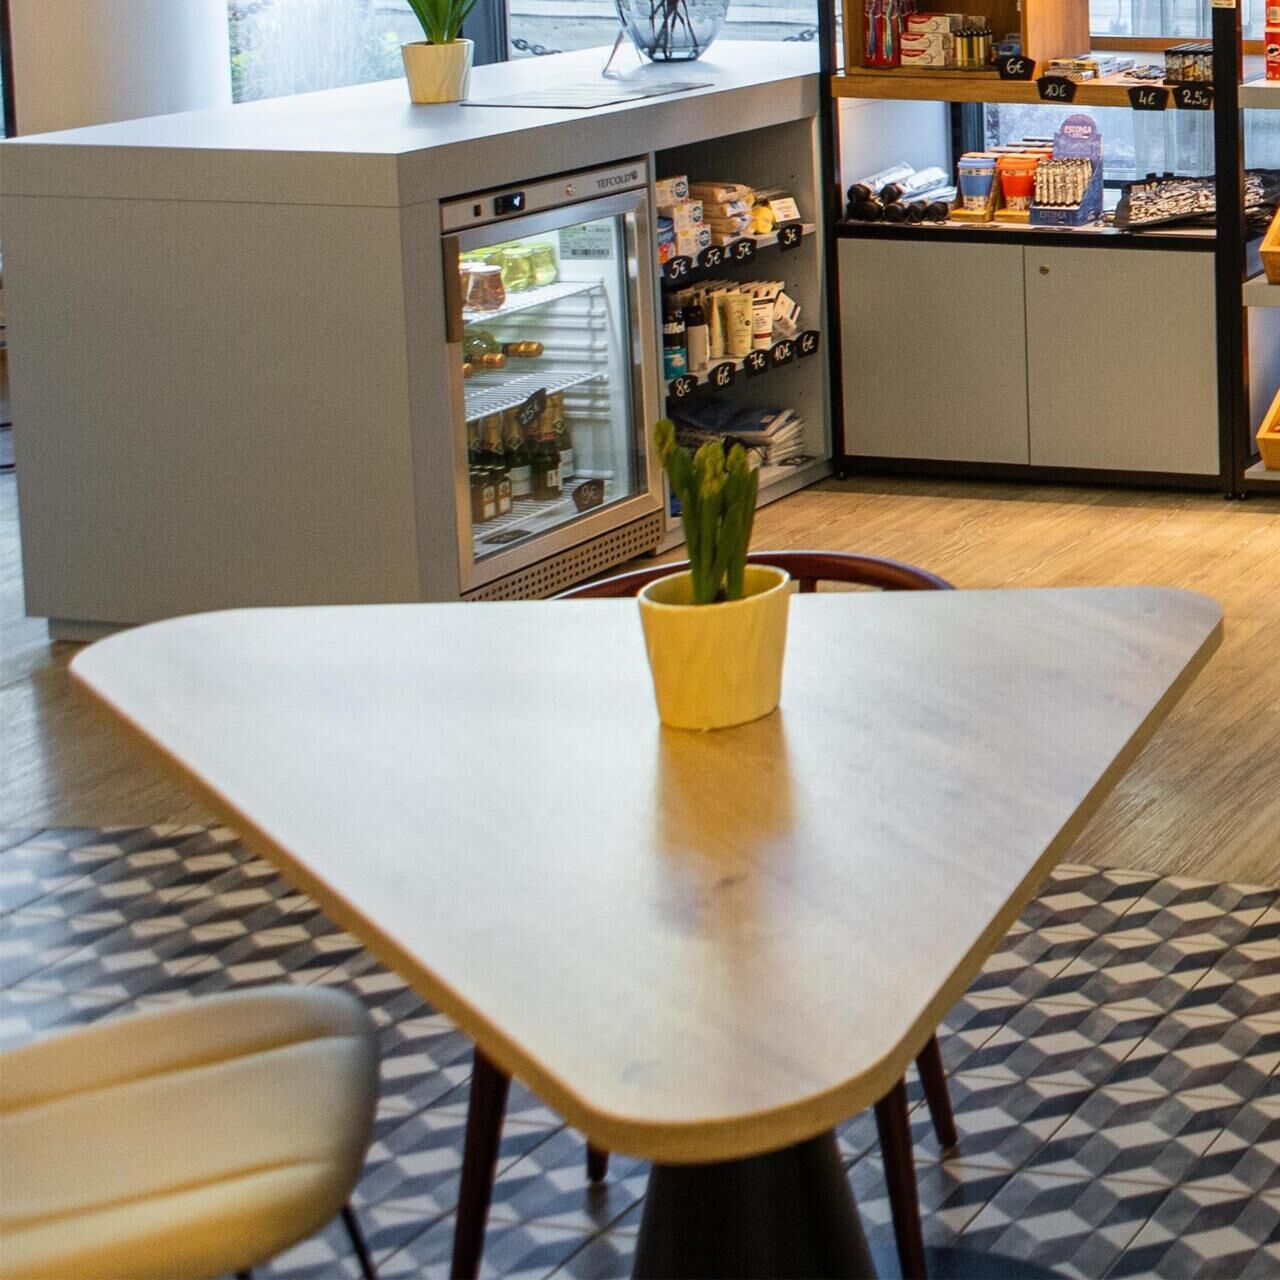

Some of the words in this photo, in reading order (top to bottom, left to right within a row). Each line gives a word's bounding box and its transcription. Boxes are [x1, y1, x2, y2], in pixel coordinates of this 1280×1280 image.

[1006, 58, 1025, 74] 6€
[1045, 83, 1067, 97] 10€
[1139, 91, 1155, 105] 4€
[784, 228, 797, 245] 3€
[705, 248, 720, 268] 5€
[736, 240, 752, 259] 5€
[670, 259, 687, 279] 5€
[774, 342, 792, 361] 10€
[802, 334, 815, 352] 6€
[750, 354, 765, 369] 7€
[717, 366, 731, 386] 6€
[676, 378, 691, 398] 8€
